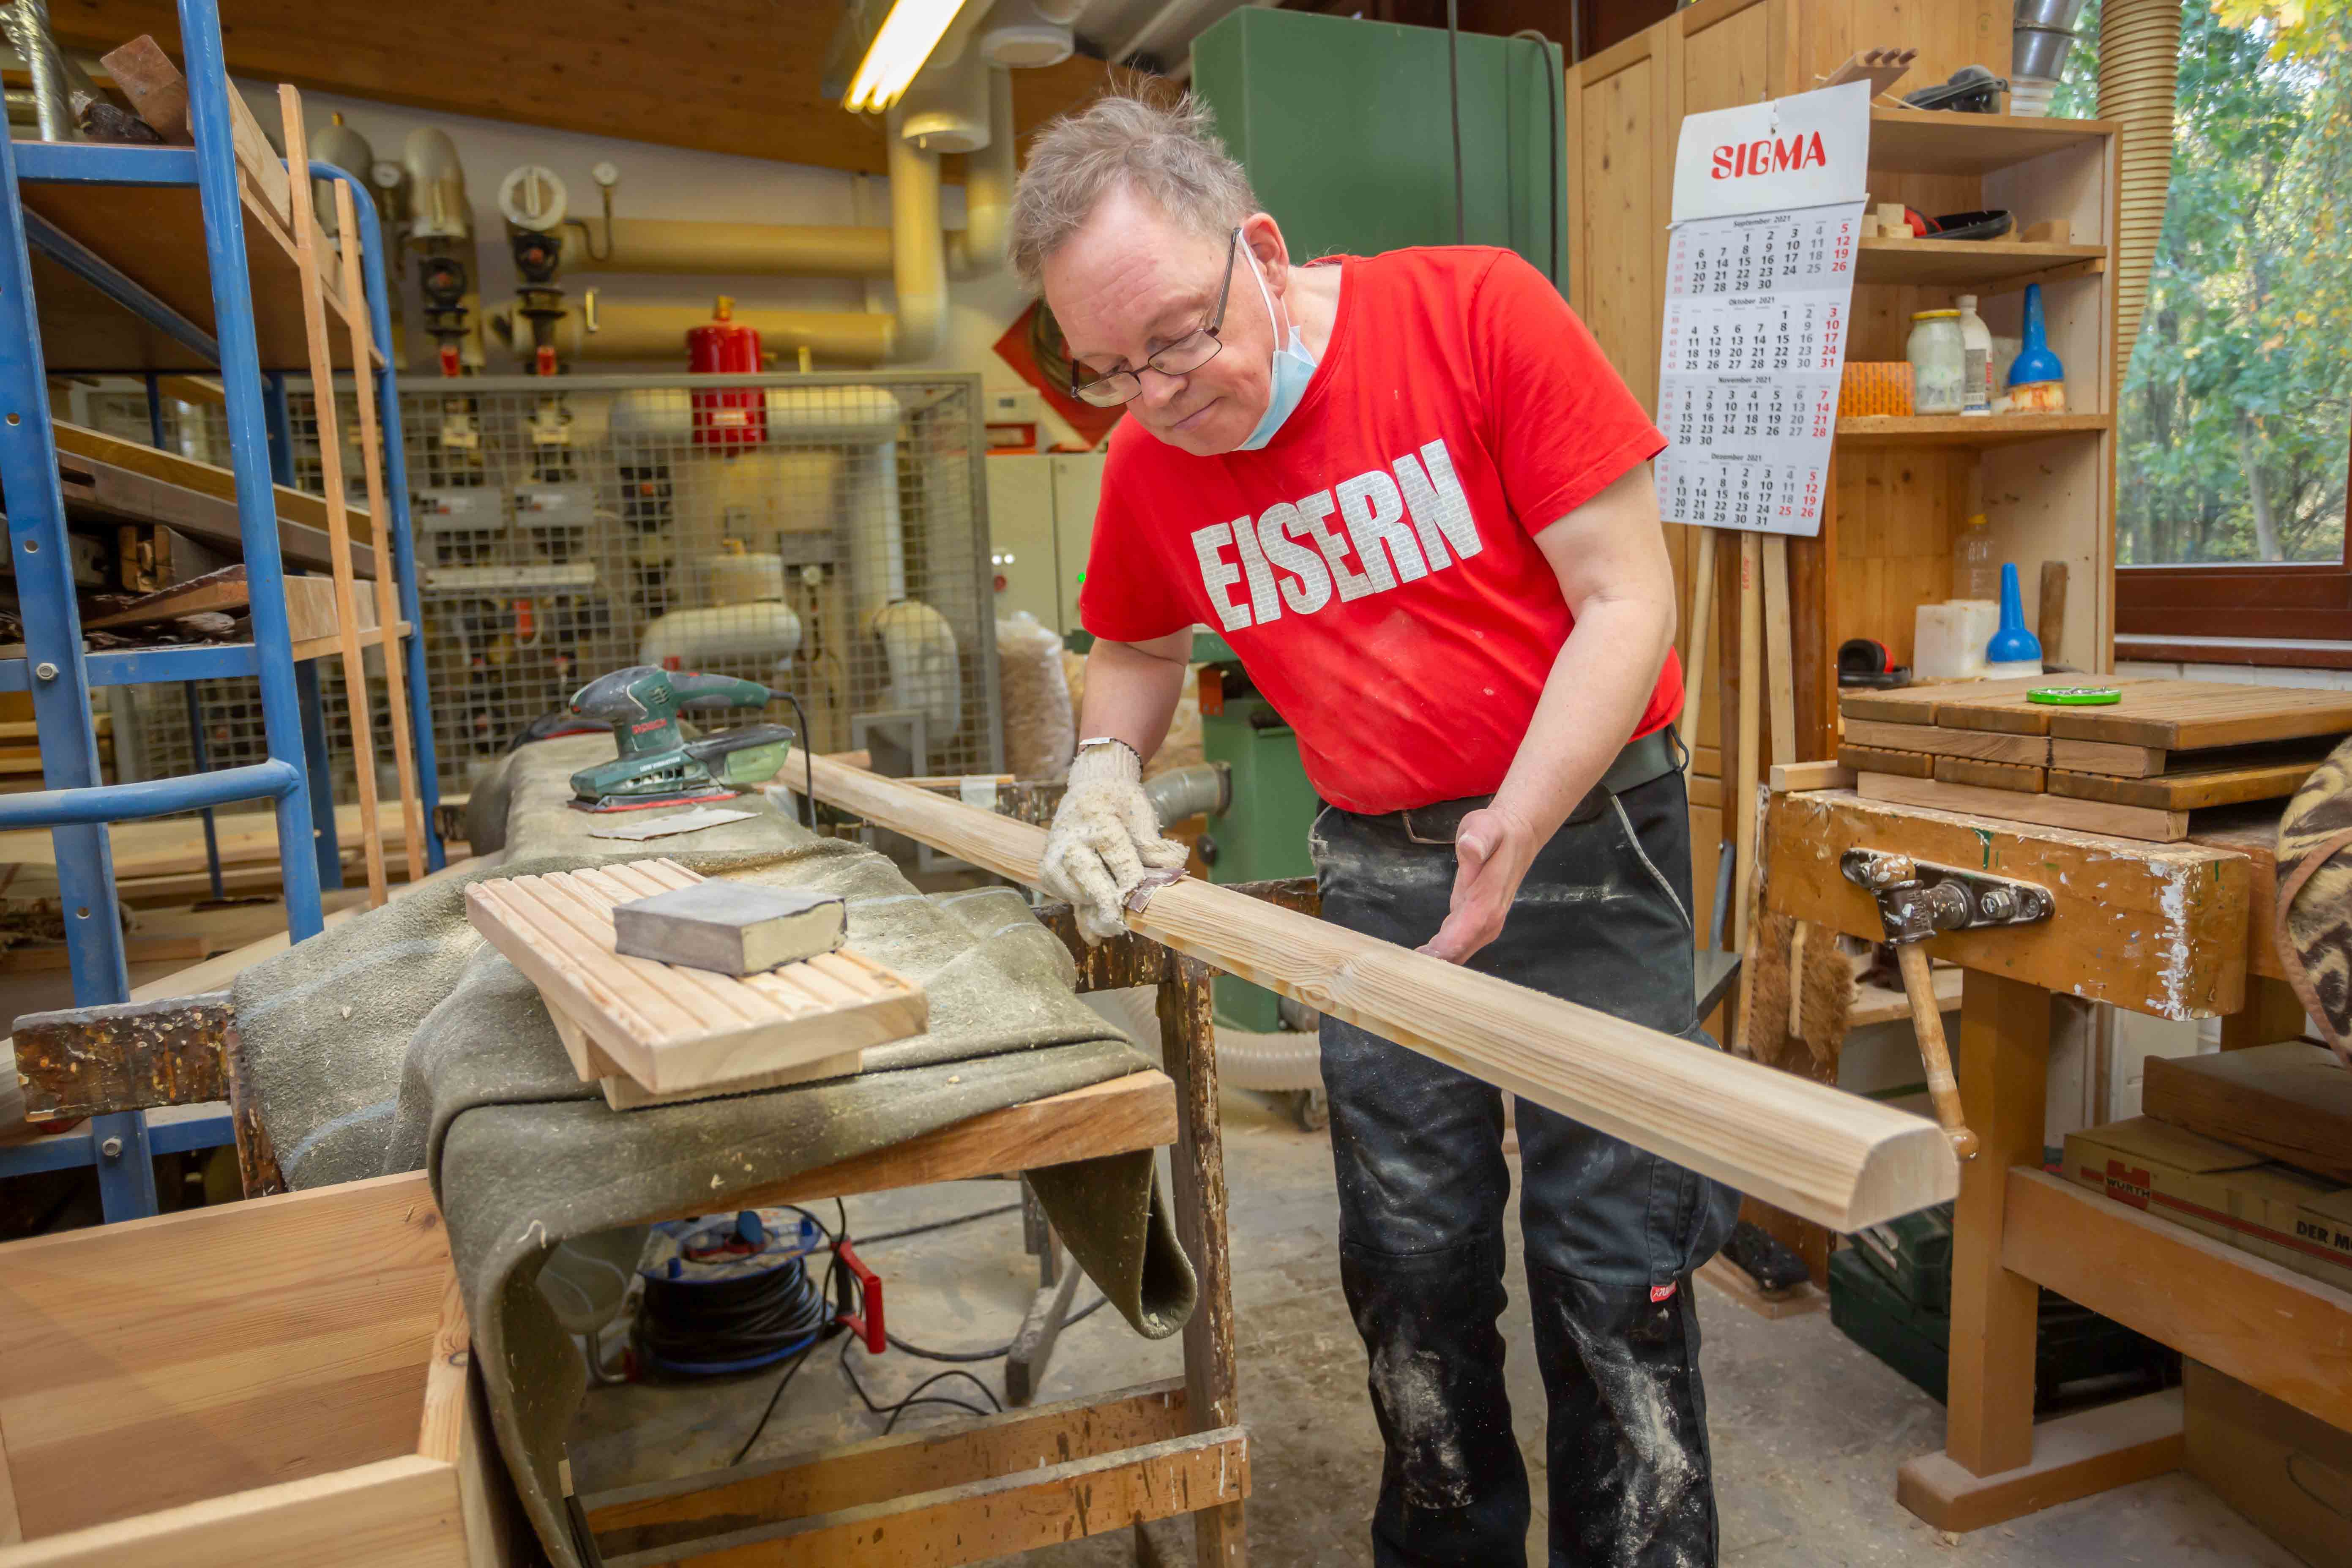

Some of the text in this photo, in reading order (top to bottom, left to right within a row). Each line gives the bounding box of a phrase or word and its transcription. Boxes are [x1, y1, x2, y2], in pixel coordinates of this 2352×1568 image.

[1711, 131, 1826, 180] SIGMA
[1734, 215, 1791, 227] September 2021
[1746, 224, 1848, 242] 1 2 3 4 5
[1699, 236, 1849, 258] 6 7 8 9 10 11 12
[1695, 261, 1706, 270] 13
[1717, 259, 1728, 268] 14
[1739, 257, 1751, 266] 15
[1762, 255, 1774, 264] 16
[1786, 254, 1798, 262] 17
[1810, 251, 1822, 260] 18
[1835, 249, 1848, 258] 19
[1693, 273, 1705, 281] 20
[1715, 271, 1726, 280] 21
[1737, 269, 1749, 279] 22
[1760, 268, 1772, 276] 23
[1783, 265, 1796, 275] 24
[1807, 264, 1821, 273] 25
[1832, 262, 1846, 271] 26
[1692, 284, 1704, 293] 27
[1714, 283, 1726, 292] 28
[1735, 281, 1748, 290] 29
[1758, 280, 1771, 289] 30
[1806, 309, 1812, 318] 2
[1830, 308, 1837, 317] 3
[1713, 325, 1718, 334] 5
[1735, 325, 1740, 333] 6
[1758, 324, 1763, 332] 7
[1781, 323, 1787, 331] 8
[1805, 322, 1811, 331] 9
[1827, 320, 1839, 329] 10
[1689, 338, 1699, 346] 11
[1710, 337, 1721, 346] 12
[1732, 336, 1743, 345] 13
[1755, 336, 1766, 344] 14
[1778, 335, 1789, 344] 15
[1801, 334, 1812, 343] 16
[1825, 333, 1838, 342] 17
[1688, 350, 1699, 358] 18
[1709, 349, 1720, 357] 19
[1730, 348, 1742, 357] 20
[1752, 348, 1763, 356] 21
[1775, 347, 1788, 356] 22
[1799, 346, 1811, 355] 23
[1822, 346, 1836, 355] 24
[1686, 361, 1697, 369] 25
[1707, 361, 1719, 369] 26
[1729, 360, 1741, 369] 27
[1751, 359, 1764, 369] 28
[1774, 359, 1787, 368] 29
[1797, 358, 1810, 368] 30
[1821, 358, 1833, 368] 31
[1687, 391, 1828, 400] 1 2 3 4 5 6 7
[1685, 402, 1829, 412] 8 9 10 11 12 13 14
[1682, 413, 1826, 424] 15 16 17 18 19 20 21
[1680, 424, 1691, 433] 22
[1701, 425, 1713, 433] 23
[1723, 425, 1734, 434] 24
[1745, 426, 1756, 435] 25
[1767, 426, 1778, 435] 26
[1789, 427, 1802, 436] 27
[1812, 428, 1826, 437] 28
[1680, 435, 1712, 445] 29 30
[1743, 468, 1748, 477] 2
[1765, 470, 1770, 478] 3
[1787, 471, 1793, 479] 4
[1810, 472, 1816, 481] 5
[1679, 476, 1684, 485] 6
[1700, 477, 1705, 485] 7
[1720, 479, 1726, 488] 8
[1742, 480, 1748, 488] 9
[1761, 481, 1773, 490] 10
[1784, 483, 1794, 492] 11
[1806, 484, 1817, 493] 12
[1677, 487, 1686, 496] 13
[1696, 489, 1707, 497] 14
[1717, 490, 1727, 498] 15
[1739, 492, 1749, 500] 16
[1759, 493, 1771, 501] 17
[1782, 494, 1793, 503] 18
[1804, 496, 1816, 505] 19
[1675, 498, 1685, 507] 20
[1694, 500, 1705, 508] 21
[1715, 501, 1726, 510] 22
[1736, 503, 1747, 511] 23
[1757, 505, 1769, 513] 24
[1779, 506, 1791, 515] 25
[1801, 507, 1814, 517] 26
[1675, 509, 1685, 517] 27
[1693, 511, 1704, 520] 28
[1713, 513, 1725, 522] 29
[1735, 514, 1746, 523] 30
[1756, 516, 1767, 525] 31
[1191, 438, 1483, 632] EISERN
[631, 718, 667, 735] BOSCH
[2296, 1220, 2352, 1251] DER M
